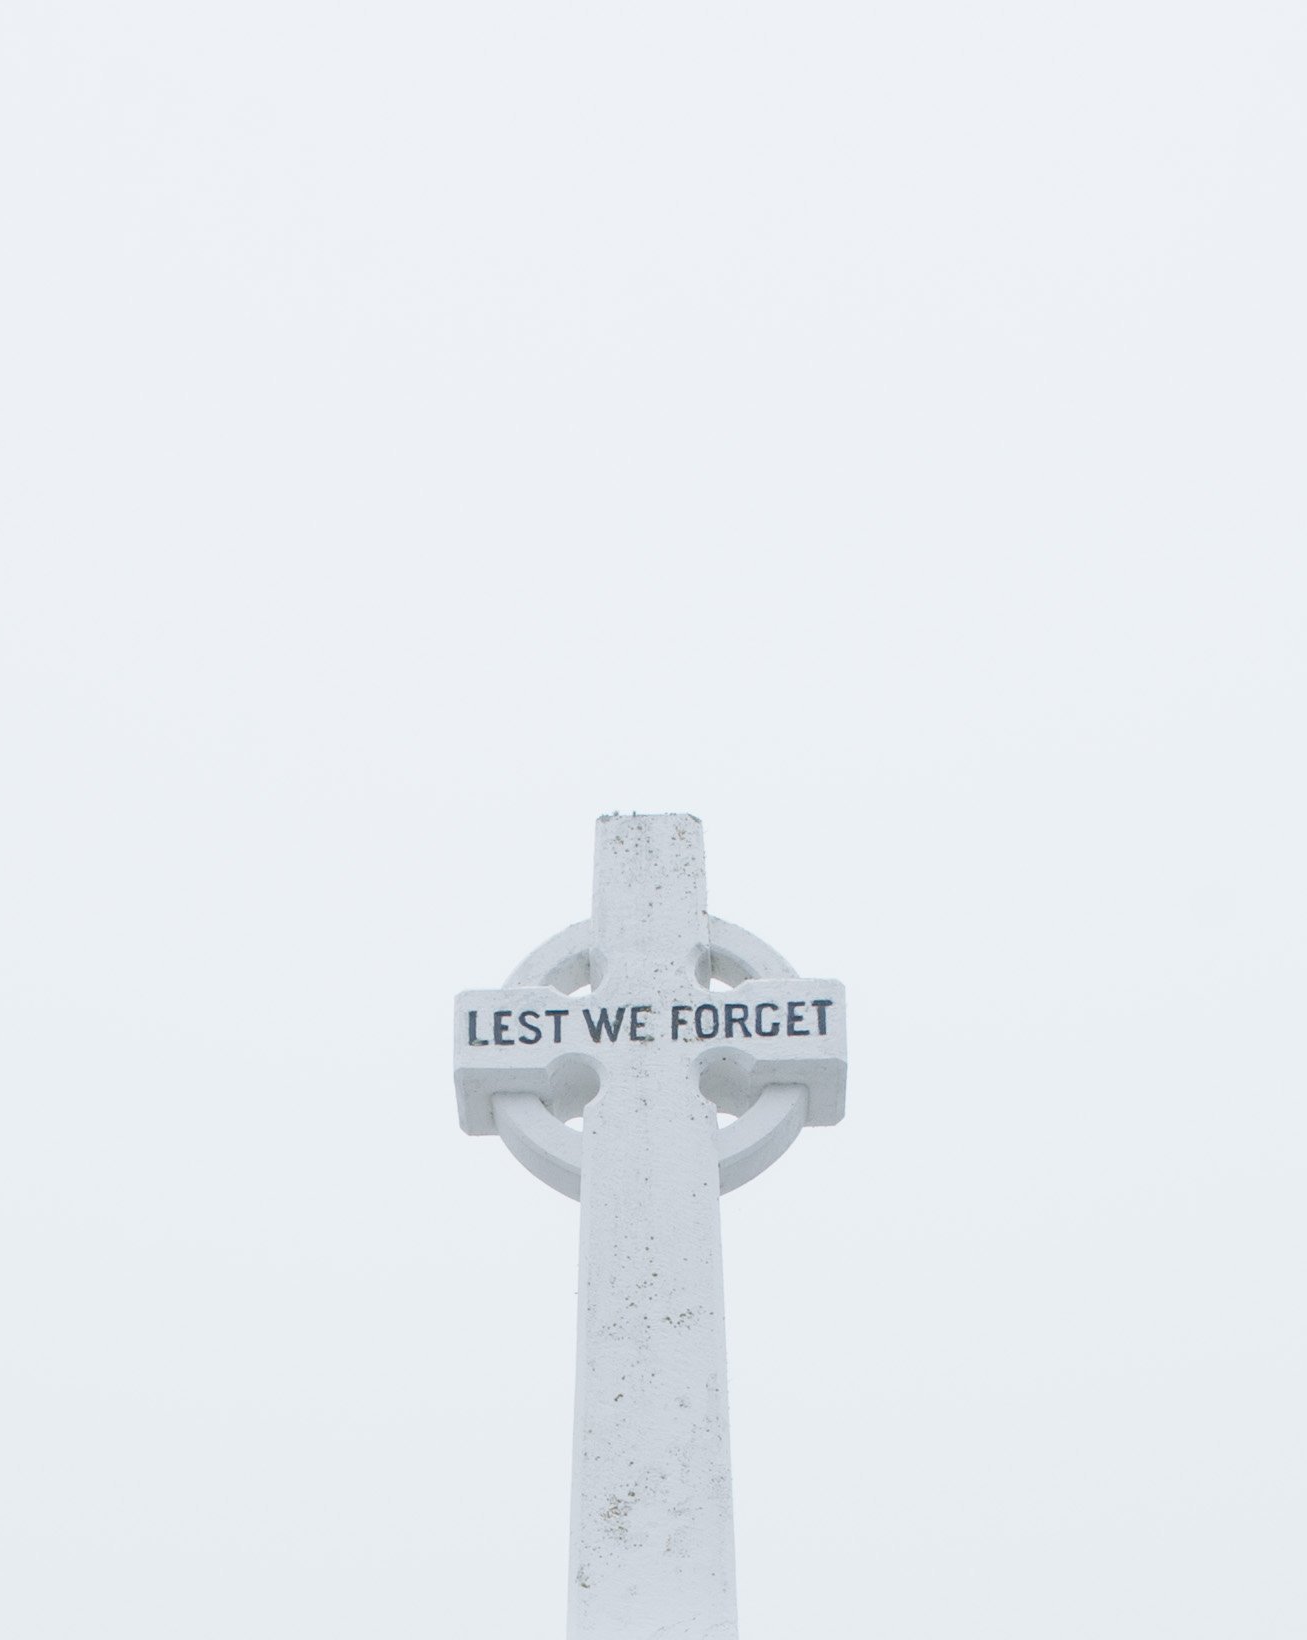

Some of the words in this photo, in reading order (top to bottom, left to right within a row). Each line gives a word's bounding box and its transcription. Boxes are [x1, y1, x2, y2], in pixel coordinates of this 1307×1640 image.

[468, 1009, 569, 1047] LEST
[582, 1005, 654, 1044] WE
[671, 999, 833, 1042] FORGET
